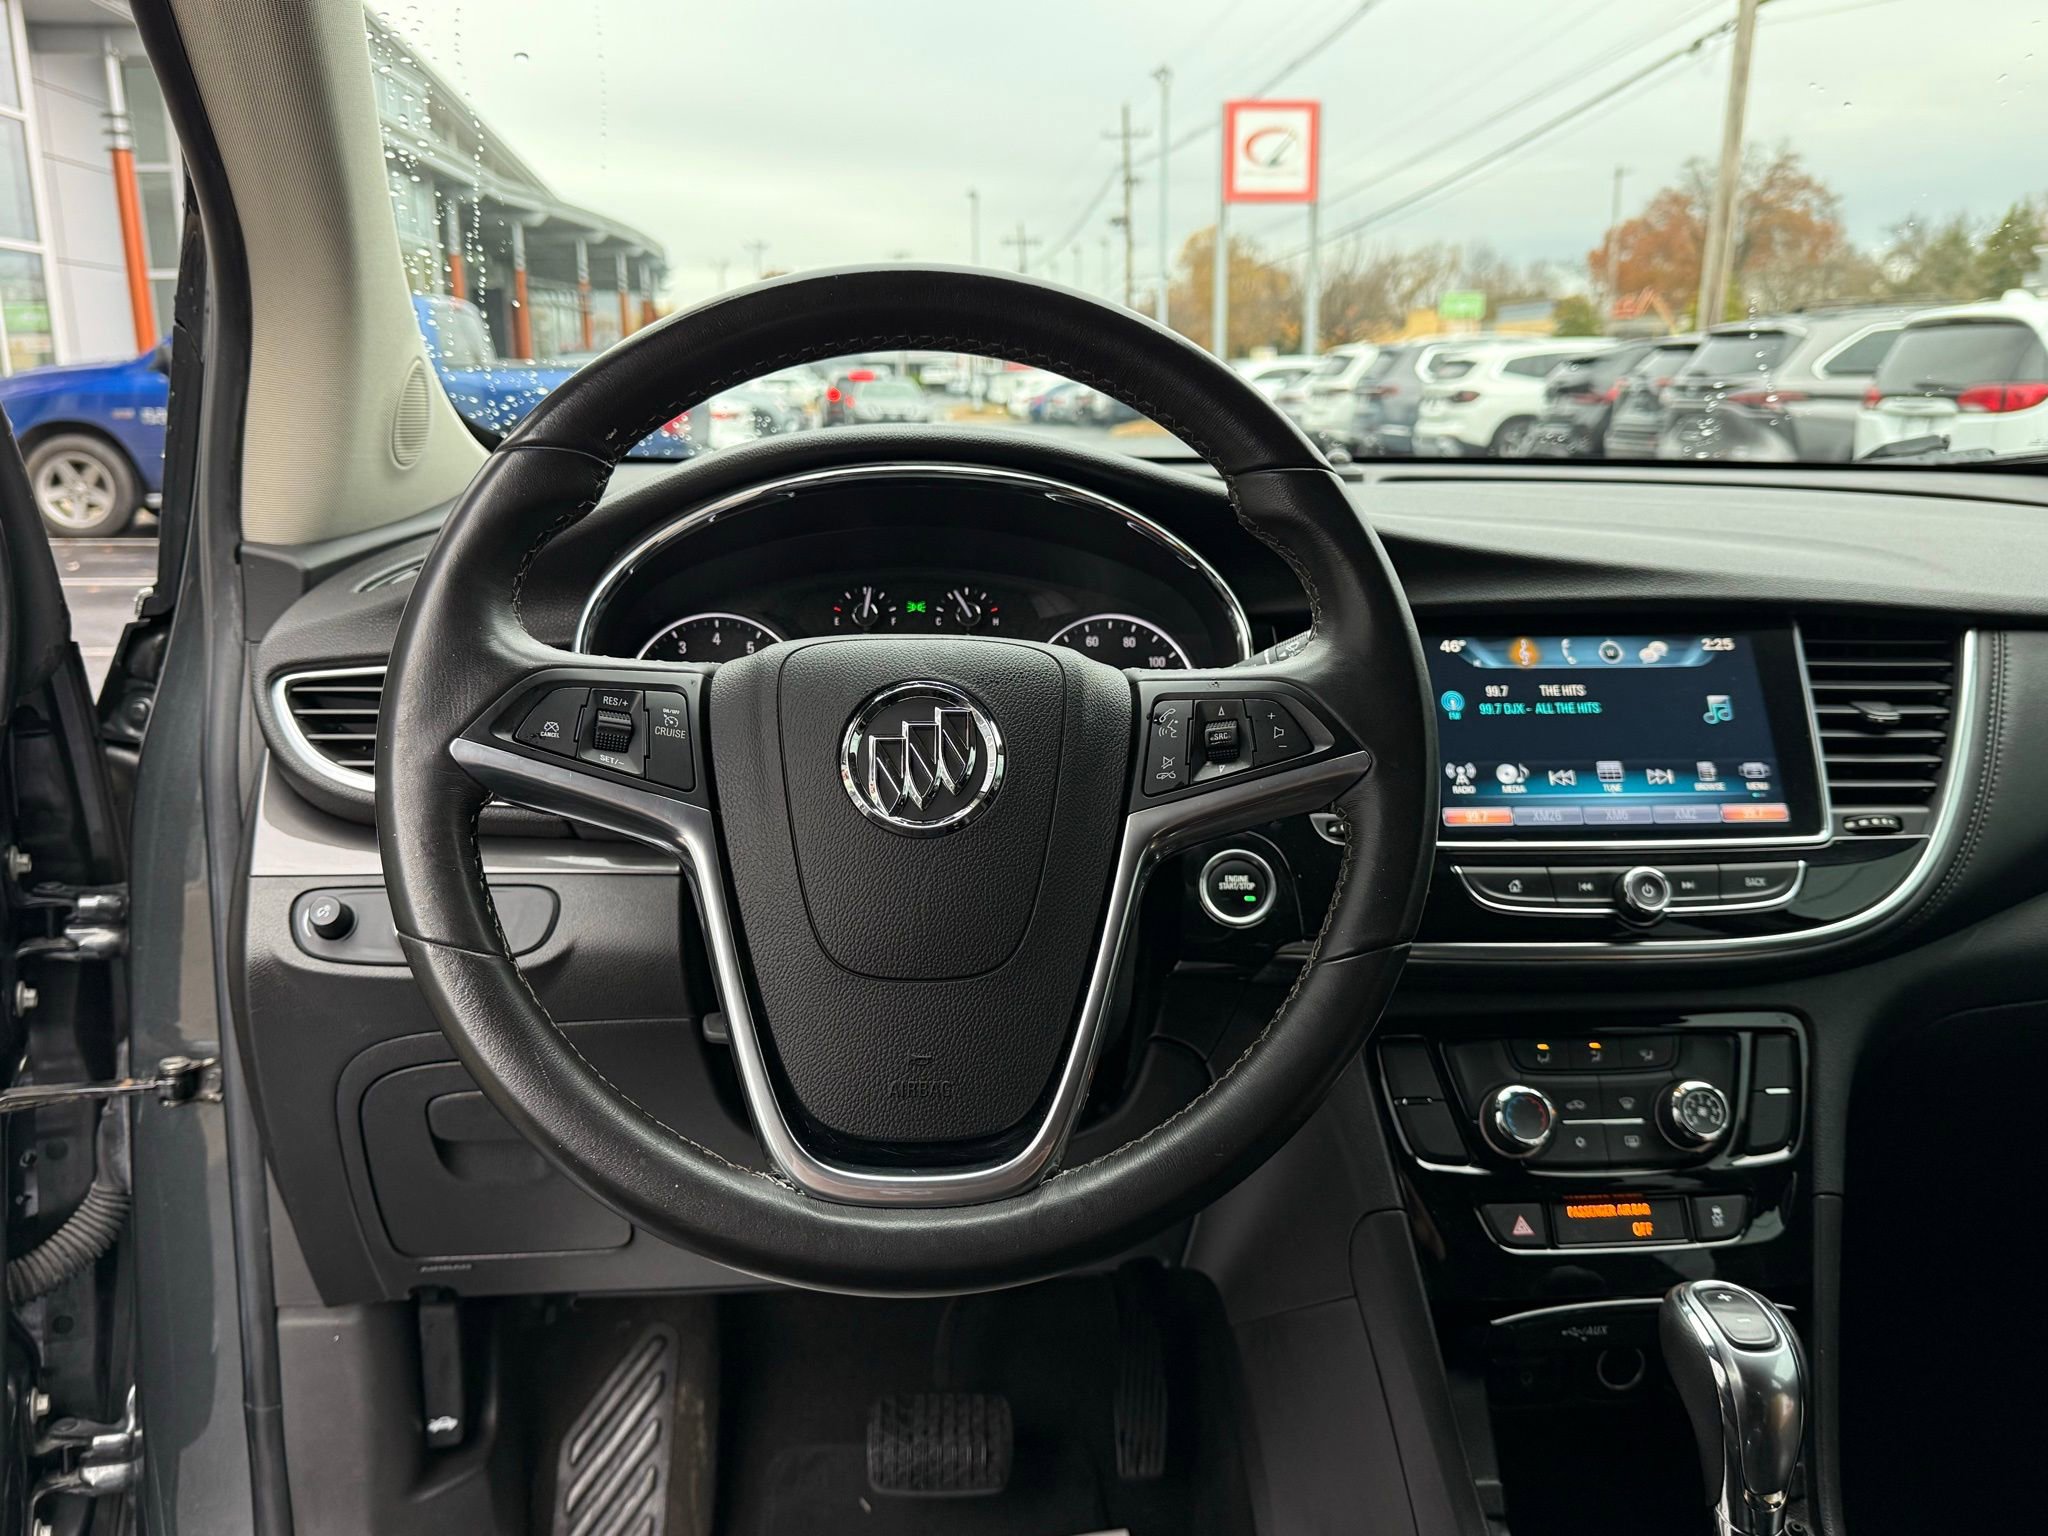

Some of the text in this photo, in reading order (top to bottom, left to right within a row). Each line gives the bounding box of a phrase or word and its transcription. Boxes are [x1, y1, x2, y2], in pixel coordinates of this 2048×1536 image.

[834, 617, 840, 626] E
[891, 617, 897, 626] F
[935, 617, 942, 626] C
[992, 617, 1000, 626] H
[712, 632, 721, 646] 4
[1086, 635, 1099, 647] 60
[1123, 636, 1136, 648] 80
[1701, 637, 1735, 651] 2:25
[678, 641, 687, 654] 3
[1148, 656, 1166, 668] 100
[1485, 685, 1509, 697] 99.7
[1539, 684, 1587, 697] THE HITS
[603, 695, 629, 707] RES/+
[1479, 703, 1501, 715] 99.7
[1504, 703, 1525, 714] DJX
[1535, 703, 1555, 714] ALL
[1555, 702, 1576, 714] THE
[1577, 702, 1602, 714] HITS
[540, 731, 560, 739] CANCEL
[654, 725, 686, 739] CRUISE
[1213, 732, 1229, 741] SRC
[1602, 783, 1624, 793] TUNE
[1224, 874, 1249, 882] ENGINE
[1218, 882, 1256, 891] START/STOP
[888, 1080, 953, 1099] AIRBAG
[1566, 1204, 1617, 1218] PASSENGER
[1632, 1221, 1654, 1237] OFF
